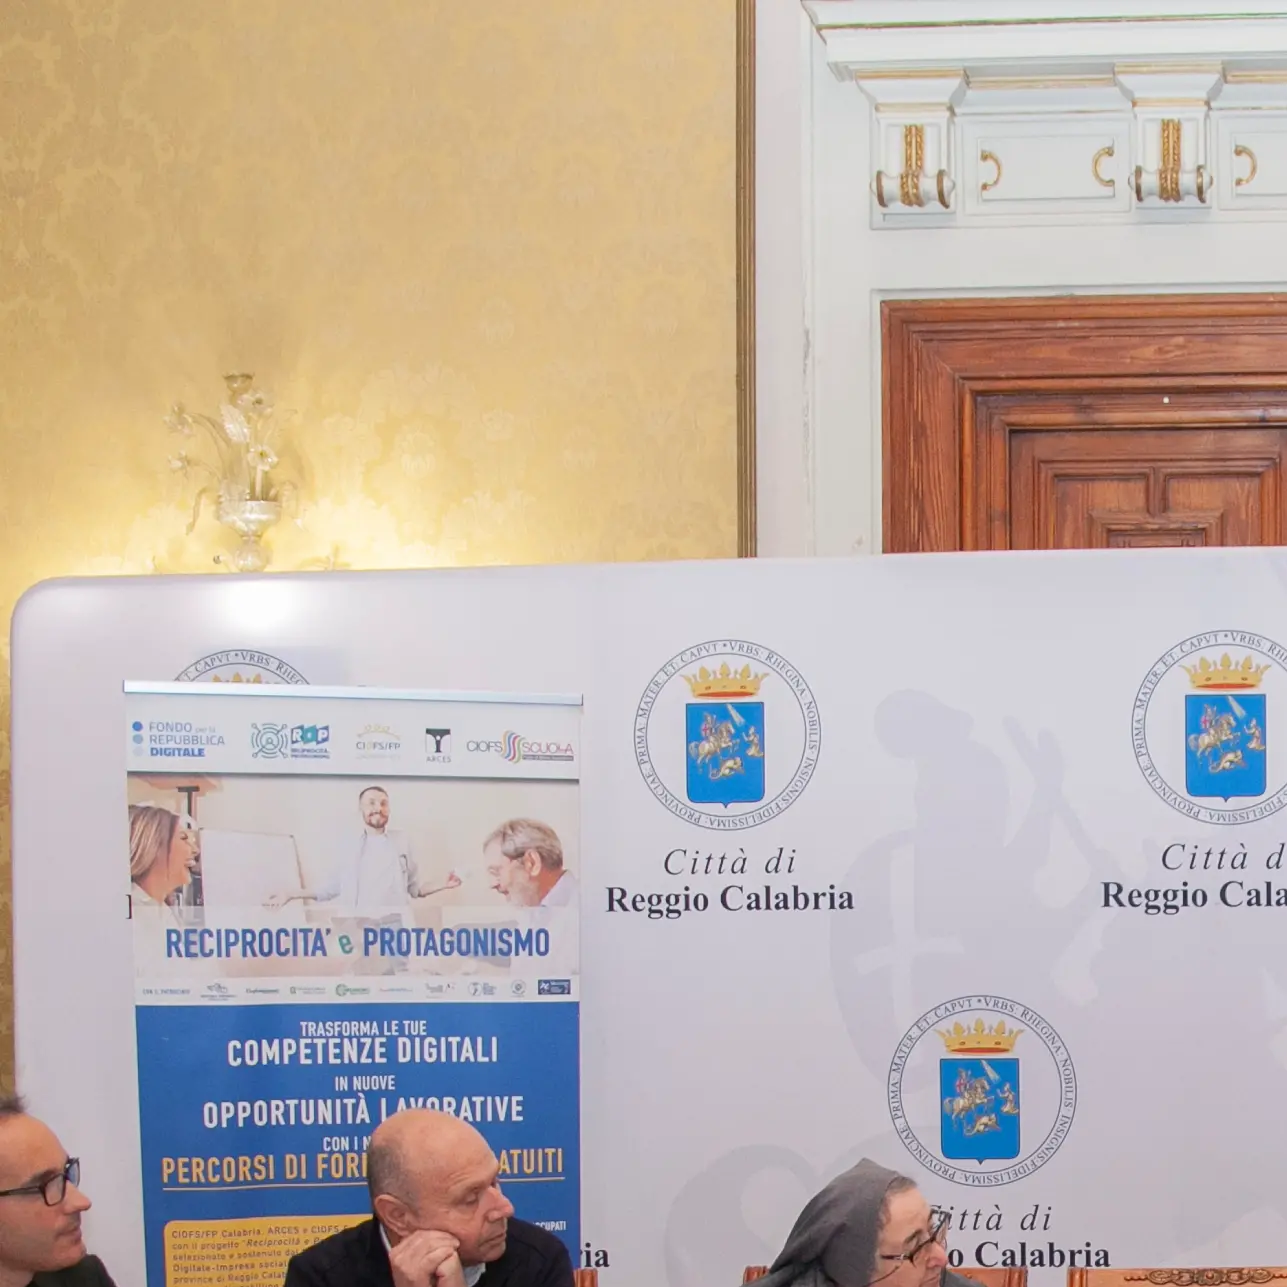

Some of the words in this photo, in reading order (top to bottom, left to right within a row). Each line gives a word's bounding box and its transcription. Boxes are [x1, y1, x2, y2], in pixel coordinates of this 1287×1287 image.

[149, 722, 192, 732] FONDO
[150, 734, 225, 746] REPUBBLICA
[356, 741, 400, 750] CIOFS/FP
[467, 740, 502, 752] CIOFS
[522, 742, 574, 754] SCUOLA
[150, 748, 205, 757] DIGITALE
[664, 848, 747, 875] Città
[765, 848, 796, 874] di
[1162, 843, 1248, 870] Città
[606, 886, 709, 919] Reggio
[720, 884, 854, 911] Calabria
[1101, 881, 1208, 914] Reggio
[338, 934, 354, 954] e
[364, 928, 550, 956] PROTAGONISMO
[300, 1020, 379, 1036] TRASFORMA
[383, 1021, 400, 1036] LE
[402, 1020, 427, 1035] TUE
[228, 1038, 388, 1066] COMPETENZE
[398, 1036, 498, 1064] DIGITALI
[334, 1076, 348, 1091] IN
[352, 1075, 396, 1091] NUOVE
[203, 1092, 370, 1128] OPPORTUNITÀ
[323, 1136, 349, 1152] CON
[354, 1136, 358, 1151] I
[162, 1154, 275, 1183] PERCORSI
[285, 1154, 307, 1180] DI
[498, 1148, 563, 1174] ATUITI
[1020, 1204, 1052, 1230] di
[268, 1226, 299, 1234] ARCES
[201, 1240, 239, 1251] progetto
[975, 1242, 1111, 1268] Calabria
